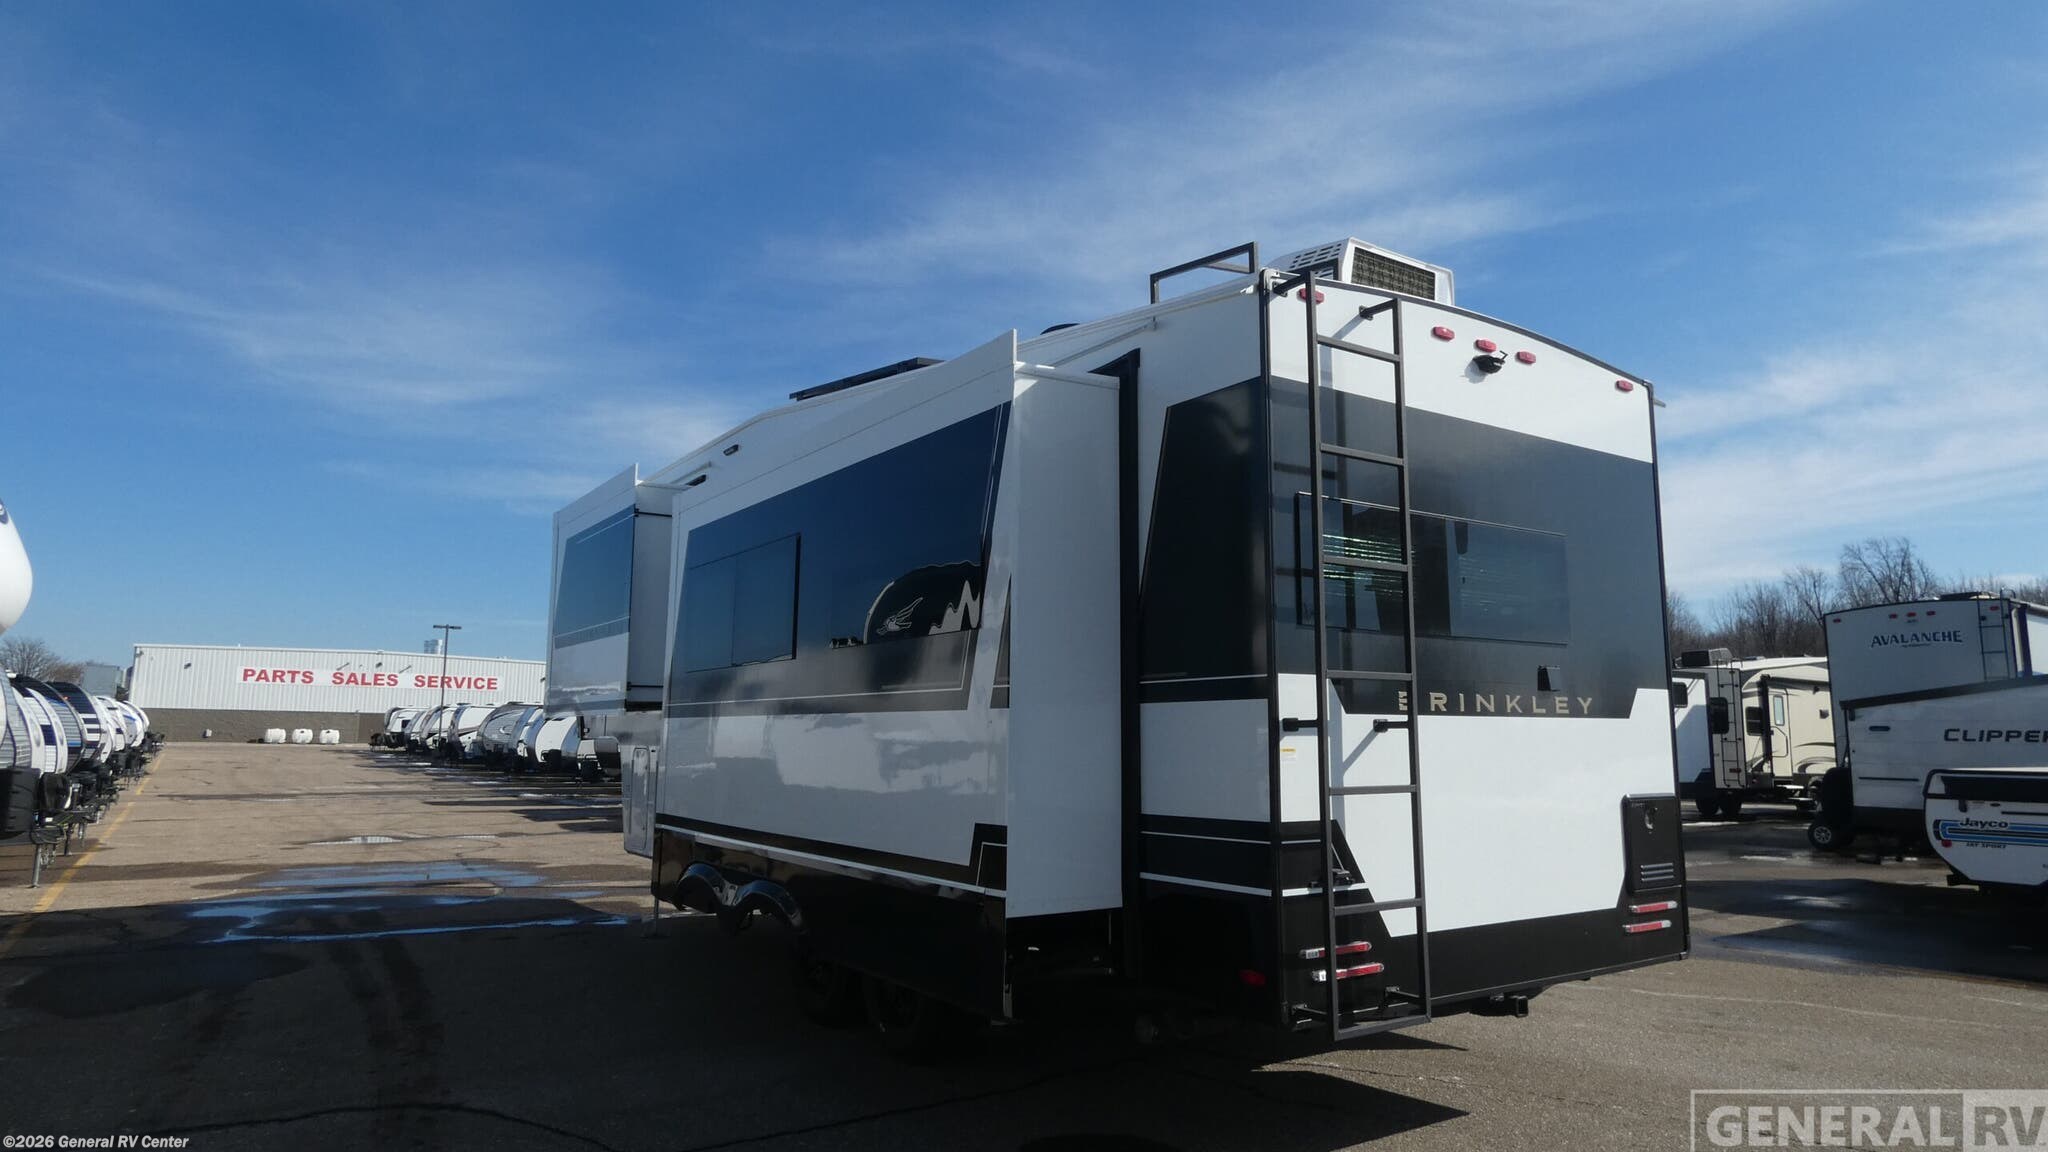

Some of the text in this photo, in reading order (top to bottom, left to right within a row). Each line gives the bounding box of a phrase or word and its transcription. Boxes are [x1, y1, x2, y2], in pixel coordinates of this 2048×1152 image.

[1870, 630, 1963, 648] AVALANCHE
[242, 668, 498, 690] PARTS SALES SERVICE
[1960, 817, 2008, 829] Jayco
